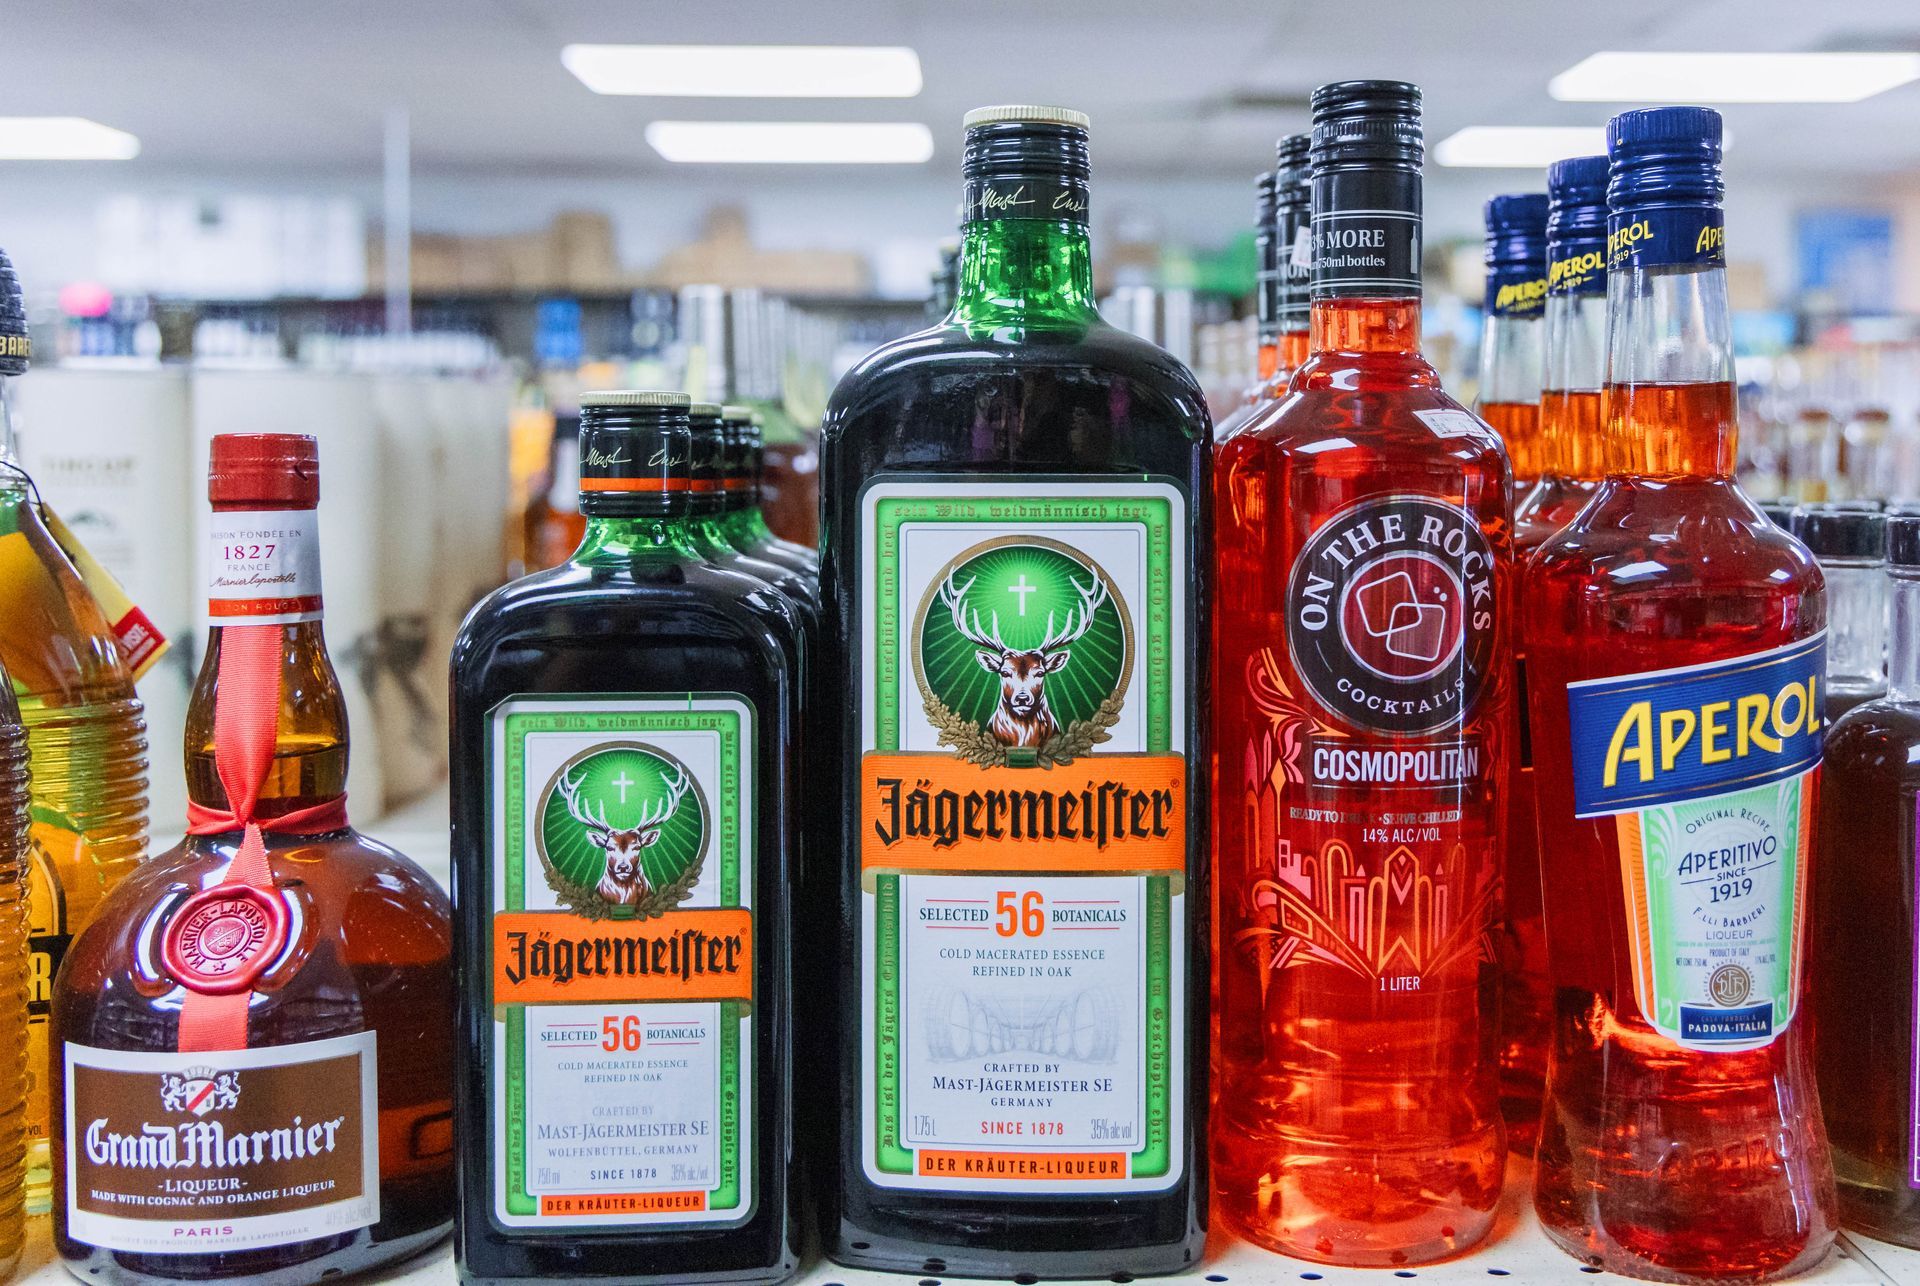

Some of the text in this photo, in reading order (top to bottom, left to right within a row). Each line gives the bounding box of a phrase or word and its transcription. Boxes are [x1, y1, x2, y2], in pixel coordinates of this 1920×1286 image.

[1326, 229, 1385, 249] MORE
[1608, 220, 1653, 257] PEROL
[1696, 226, 1725, 253] APE
[1346, 254, 1386, 267] bottles
[1548, 251, 1606, 287] APEROL
[1495, 278, 1549, 310] APERO
[289, 529, 303, 538] EN
[223, 544, 276, 560] 1827
[227, 563, 272, 572] FRANCE
[1300, 514, 1491, 631] ON THE ROCKS
[1336, 678, 1466, 715] COCKTAILS
[1603, 674, 1820, 788] APEROL
[1313, 747, 1479, 782] COSMOPOLITAN
[1685, 807, 1771, 834] ORIGINAL RECIPE
[1362, 827, 1441, 843] 14% ALC/VOL
[1677, 835, 1777, 876] APERITIVO
[1716, 867, 1747, 882] SINCE
[1709, 877, 1753, 904] 1919
[919, 890, 1127, 938] SELECTED 56 BOTANICALS
[1723, 903, 1766, 928] BARBIERI
[1705, 929, 1753, 940] LIQUEUR
[939, 948, 1105, 960] COLD MACERATED ESSENCE
[972, 966, 1072, 977] REFINED IN OAK
[1380, 976, 1420, 991] 1 LITER
[541, 1015, 706, 1052] SELECTED 56 BOTANICALS
[558, 1059, 688, 1071] COLD MACERATED ESSENCE
[983, 1063, 1061, 1073] CRAFTED BY
[584, 1073, 662, 1083] REFINED IN OAK
[932, 1075, 1113, 1092] MAST-JÄGERMEISTER SE
[592, 1105, 655, 1117] CRAFTED BY
[990, 1097, 1053, 1108] GERMANY
[537, 1120, 709, 1141] MAST-JÄGERMEISTER SE
[981, 1121, 1023, 1135] SINCE
[1031, 1122, 1064, 1135] 1878
[1090, 1118, 1109, 1140] 35%
[1121, 1121, 1132, 1139] vol
[84, 1115, 342, 1169] Grand Marnier
[644, 1143, 698, 1155] GERMANY
[590, 1169, 624, 1180] SINCE
[631, 1168, 657, 1179] 1878
[926, 1157, 1120, 1175] DER KRÄUTER-LIQUEUR
[91, 1179, 336, 1206] MADE WITH COGNAC AND ORANGE LIQUEUR
[547, 1196, 700, 1211] DER KRÄUTER-LIQUEUR
[174, 1225, 233, 1237] PARIS
